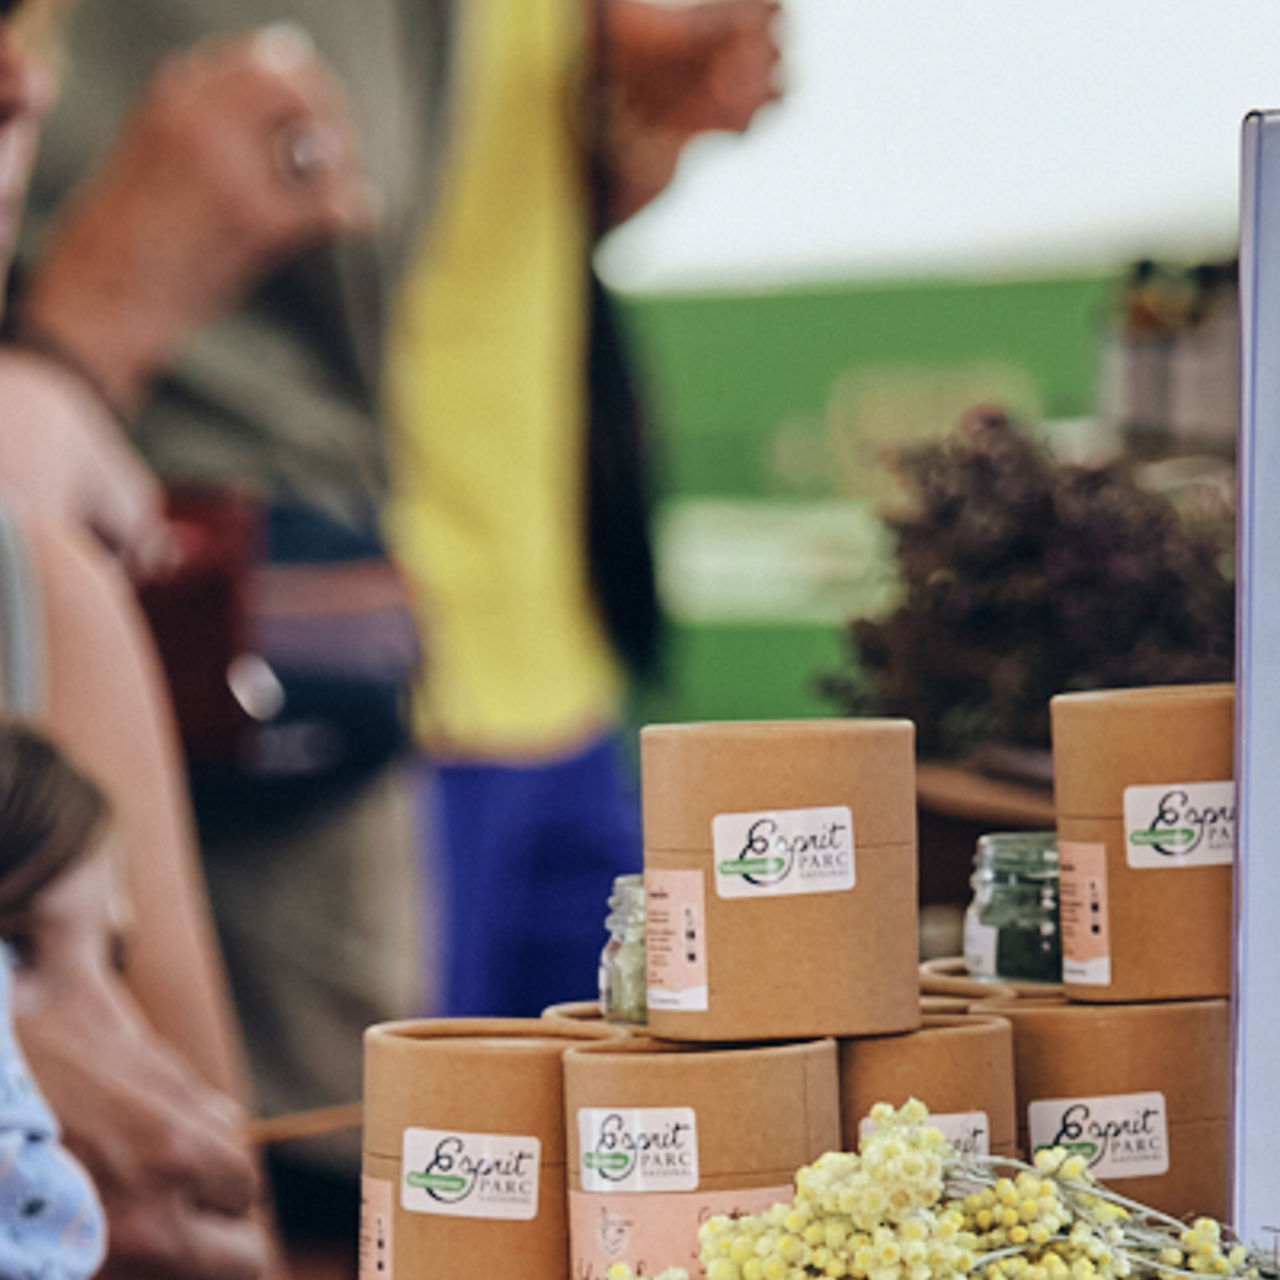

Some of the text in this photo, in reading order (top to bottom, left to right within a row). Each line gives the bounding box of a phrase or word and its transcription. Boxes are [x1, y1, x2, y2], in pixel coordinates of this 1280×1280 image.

[738, 818, 847, 887] Esprit
[798, 852, 849, 869] PARC
[596, 1113, 690, 1182] Esprit
[1053, 1103, 1159, 1169] Esprit
[1110, 1137, 1160, 1153] PARC
[425, 1136, 534, 1204] Esprit
[640, 1152, 692, 1167] PARC
[479, 1178, 532, 1194] PARC
